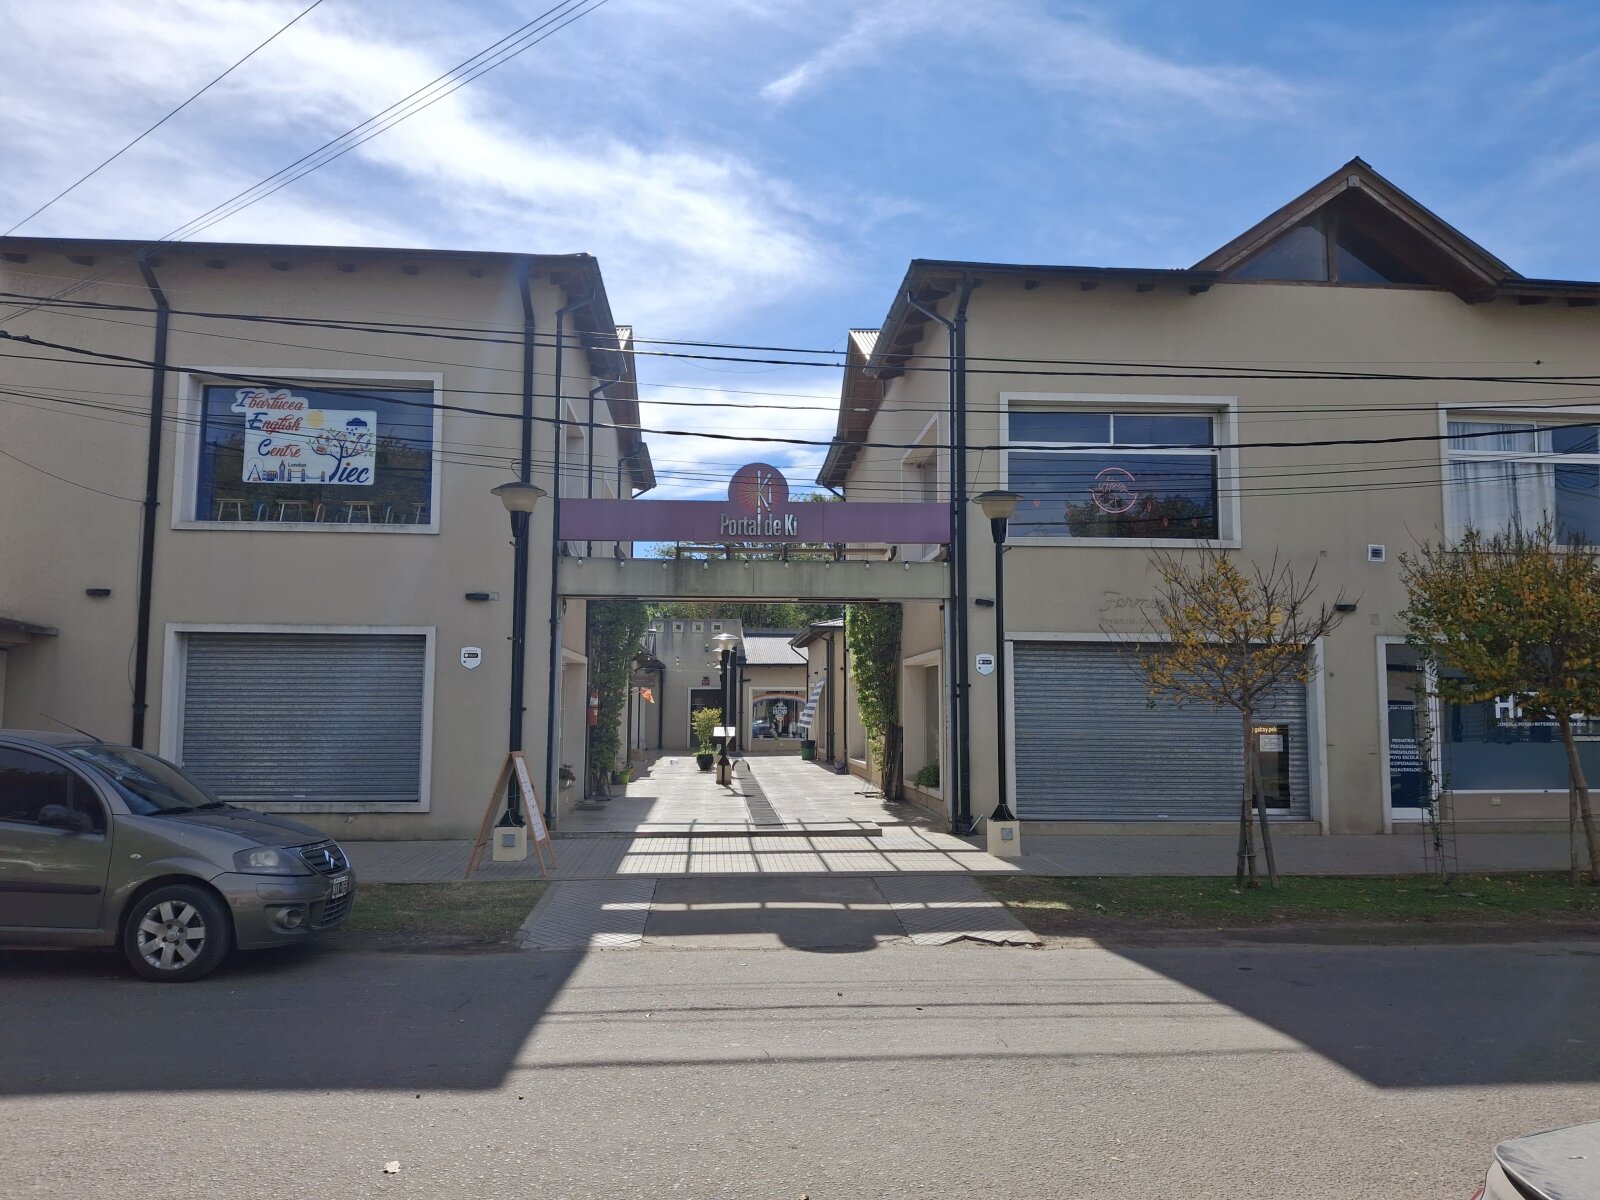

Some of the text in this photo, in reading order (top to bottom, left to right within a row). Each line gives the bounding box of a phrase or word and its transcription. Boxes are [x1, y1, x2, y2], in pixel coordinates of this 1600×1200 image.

[247, 412, 304, 435] English
[258, 438, 301, 458] Centre
[720, 513, 798, 536] Portal de Ki
